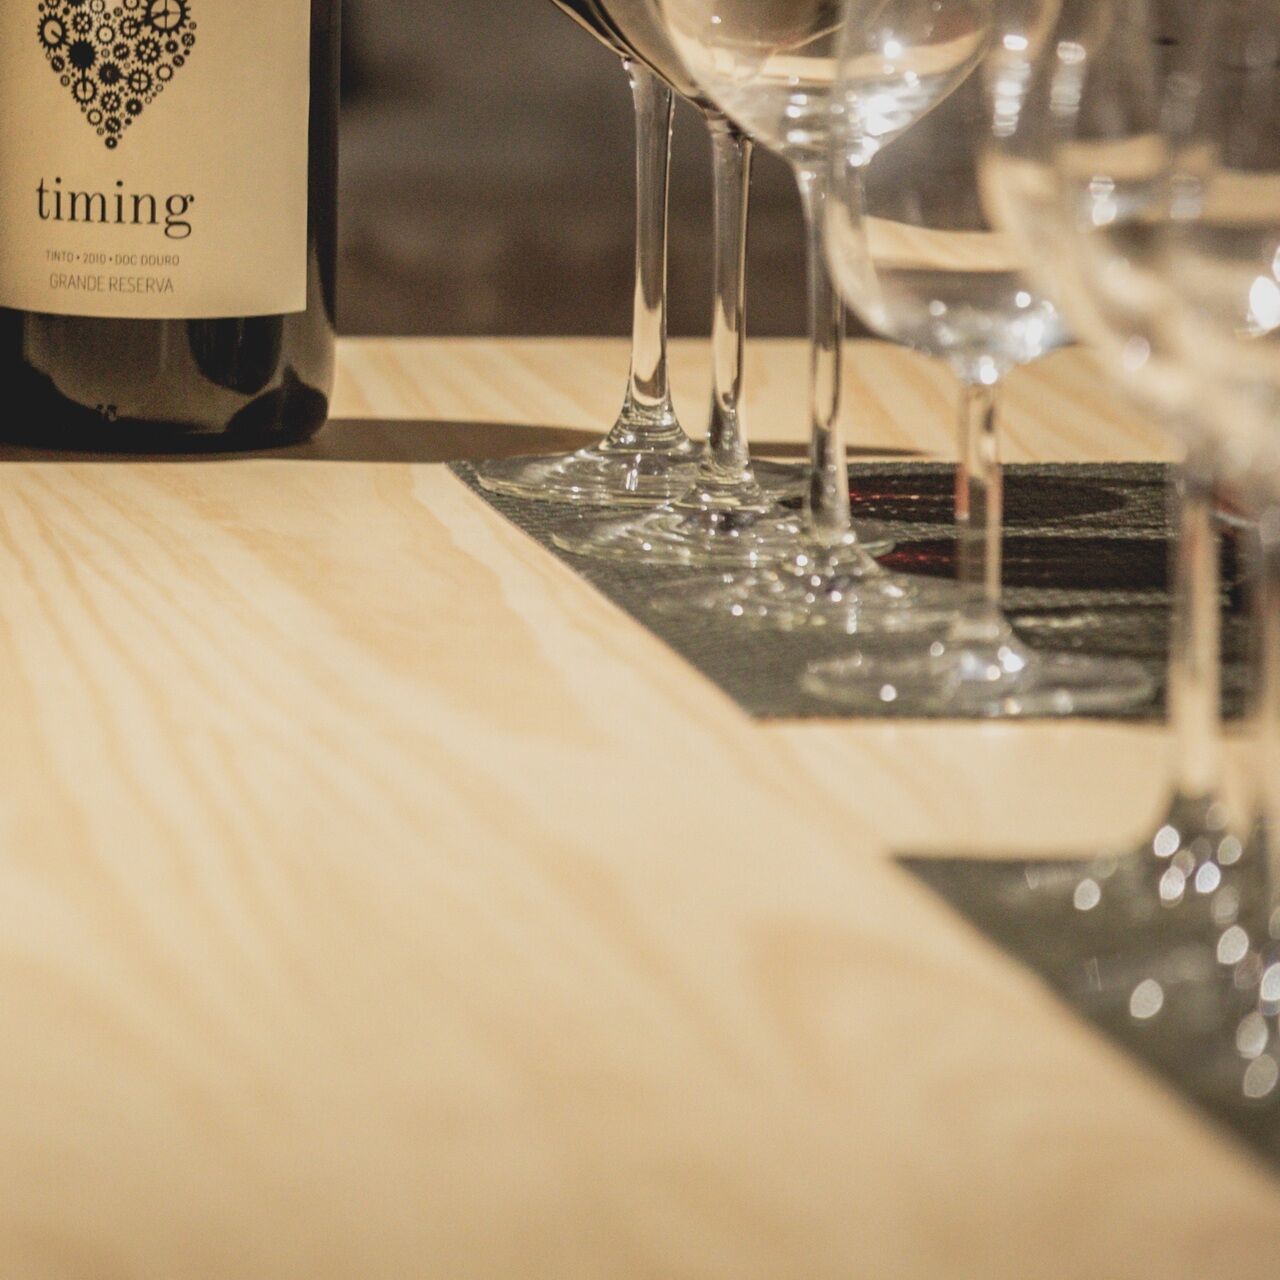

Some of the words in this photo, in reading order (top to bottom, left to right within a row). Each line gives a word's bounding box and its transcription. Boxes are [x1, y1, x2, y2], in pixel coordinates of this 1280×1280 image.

[35, 176, 196, 240] timing
[45, 248, 75, 264] TINTO
[114, 254, 138, 266] DOC
[140, 255, 180, 267] DOURO
[49, 272, 106, 292] GRANDE
[108, 276, 175, 294] RESERVA
